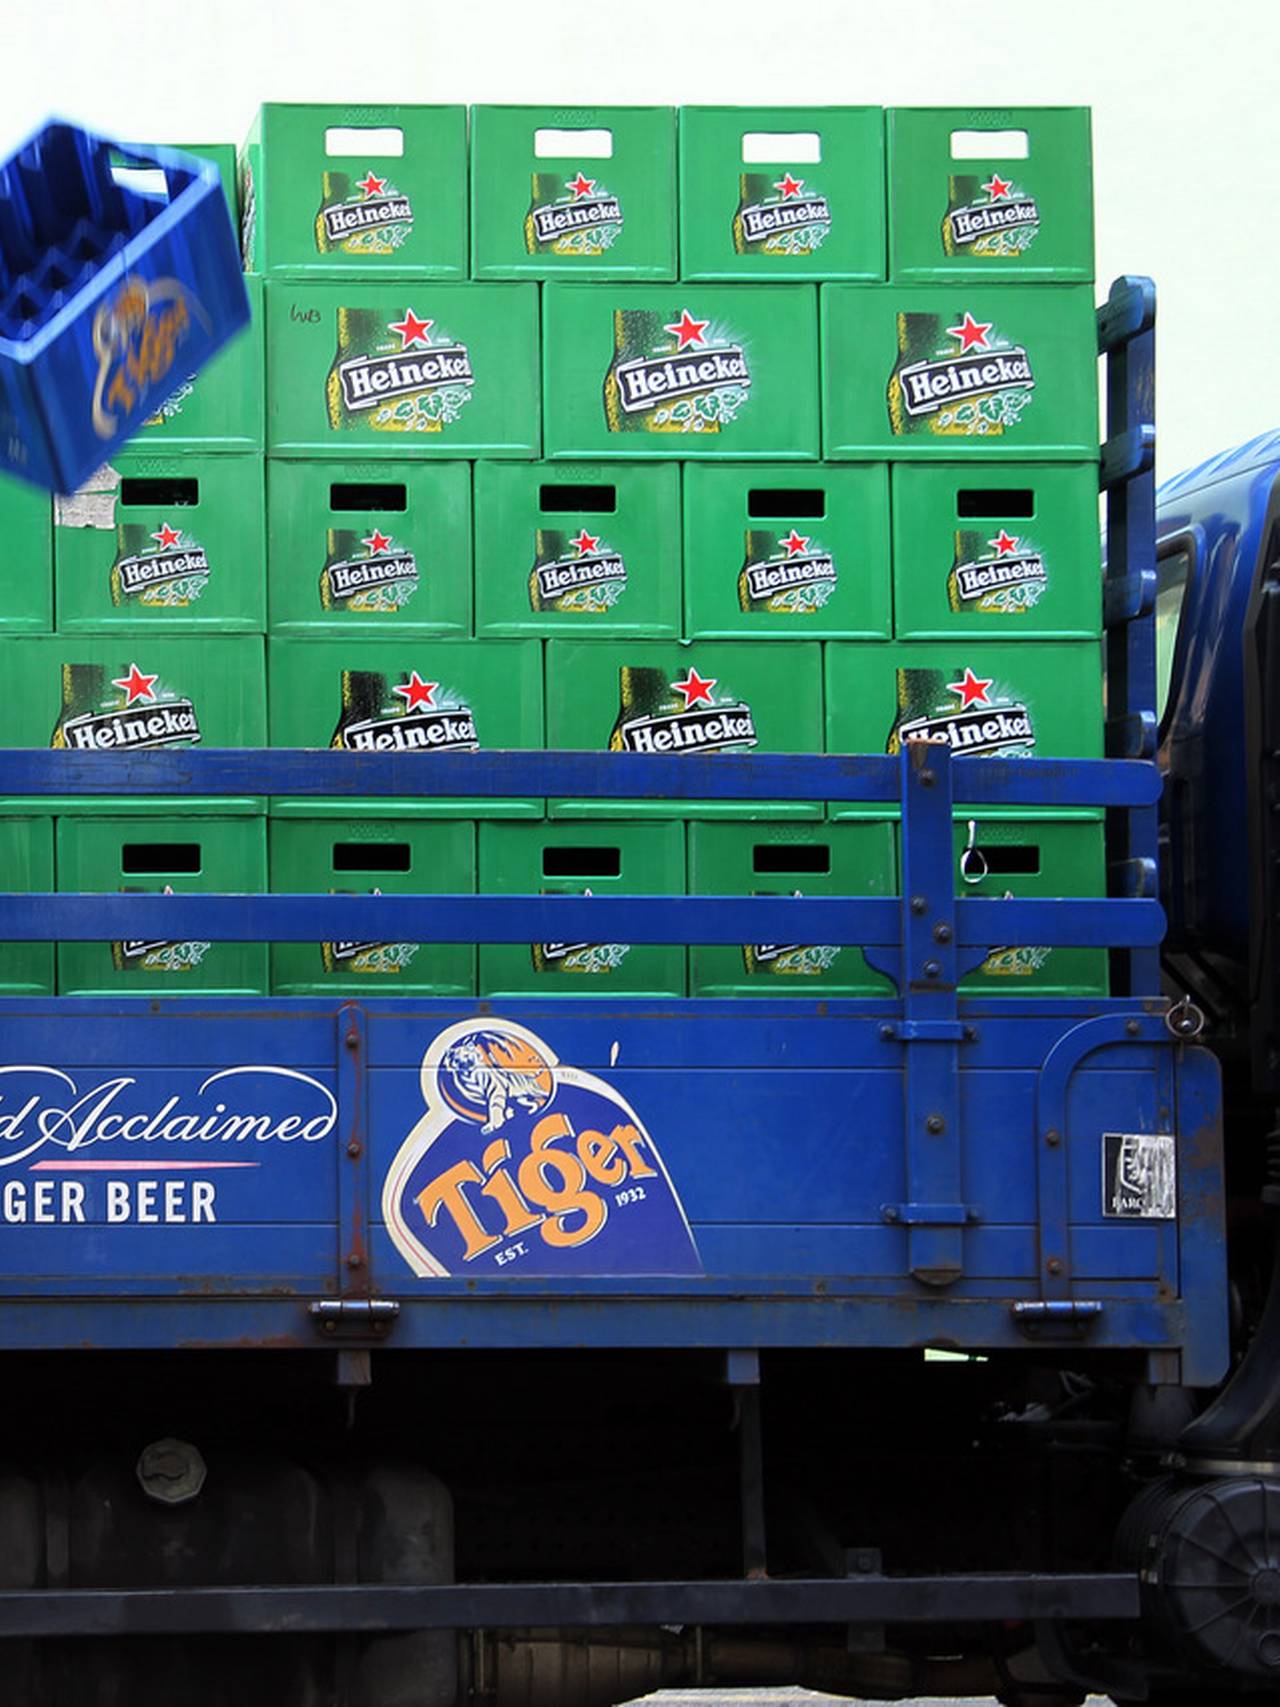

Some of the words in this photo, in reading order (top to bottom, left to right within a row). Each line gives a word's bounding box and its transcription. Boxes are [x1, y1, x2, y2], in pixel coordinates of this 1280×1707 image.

[107, 1180, 216, 1223] BEER
[415, 1113, 658, 1261] Tiger
[615, 1187, 646, 1207] 1932
